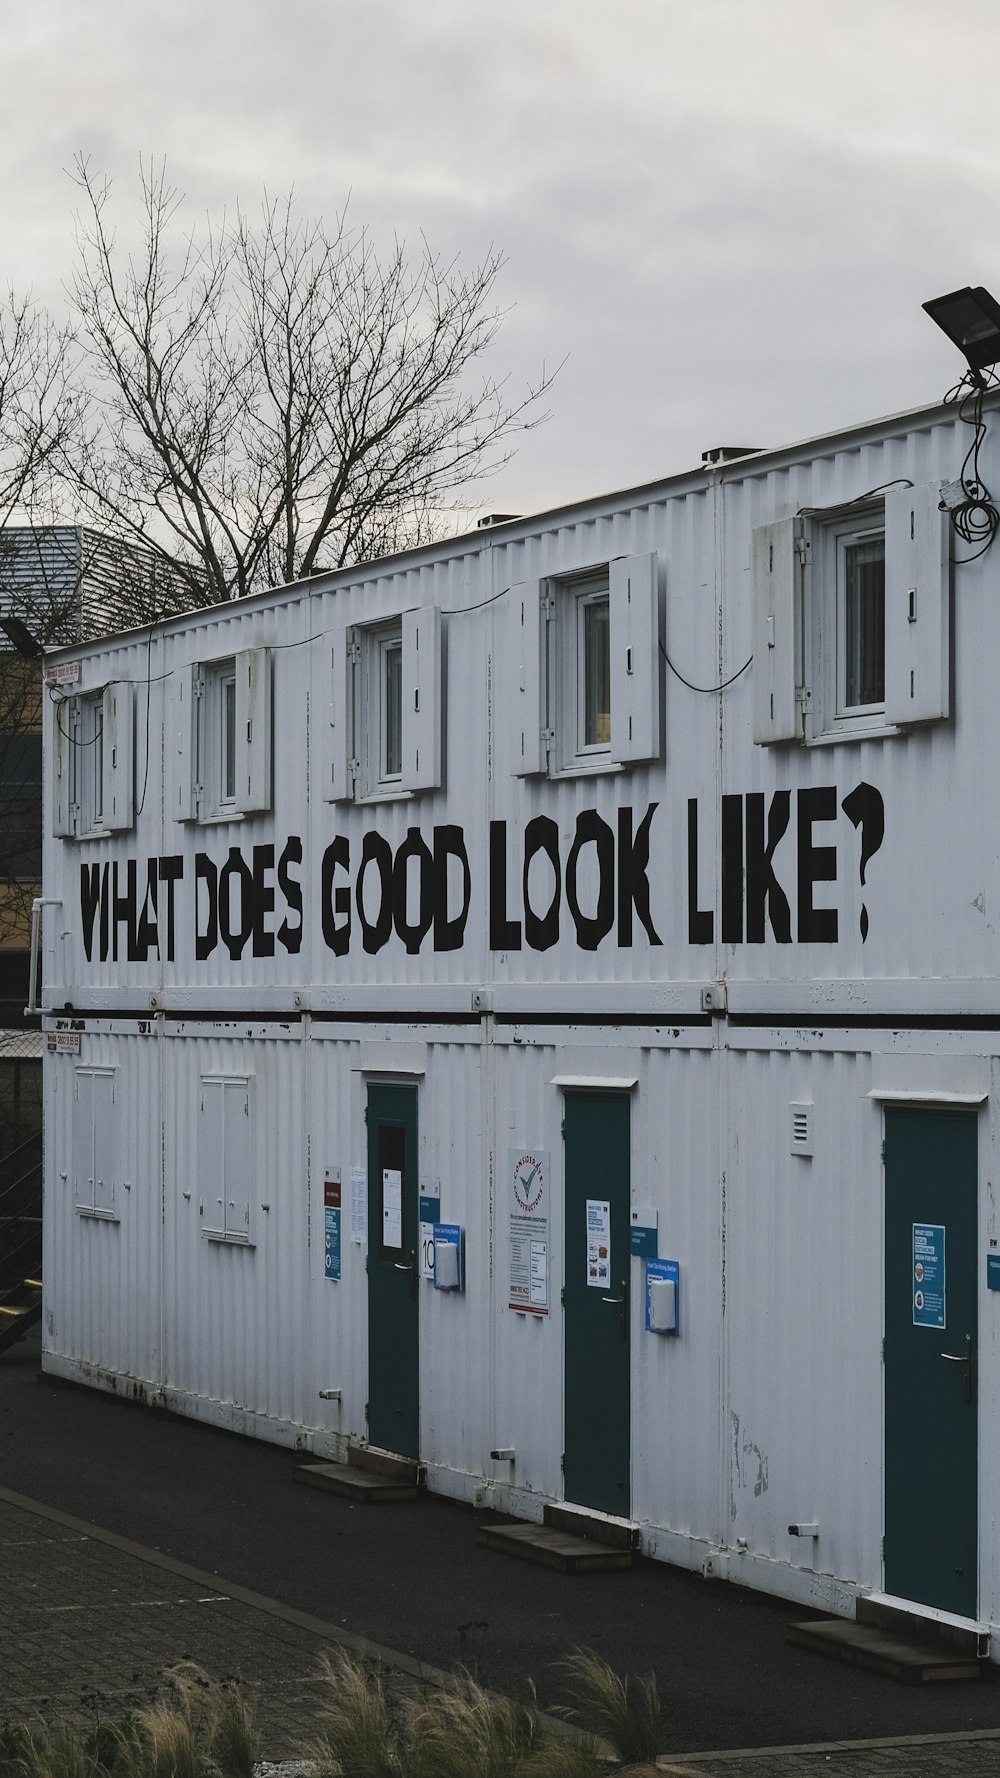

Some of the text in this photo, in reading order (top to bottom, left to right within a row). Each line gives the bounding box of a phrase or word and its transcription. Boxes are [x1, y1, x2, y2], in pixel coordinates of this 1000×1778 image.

[81, 782, 885, 962] WHAT DOES GOOD LOOK LIKE?
[514, 1155, 543, 1181] CONSIDERATE
[513, 1185, 543, 1212] CONSTRUCTORS
